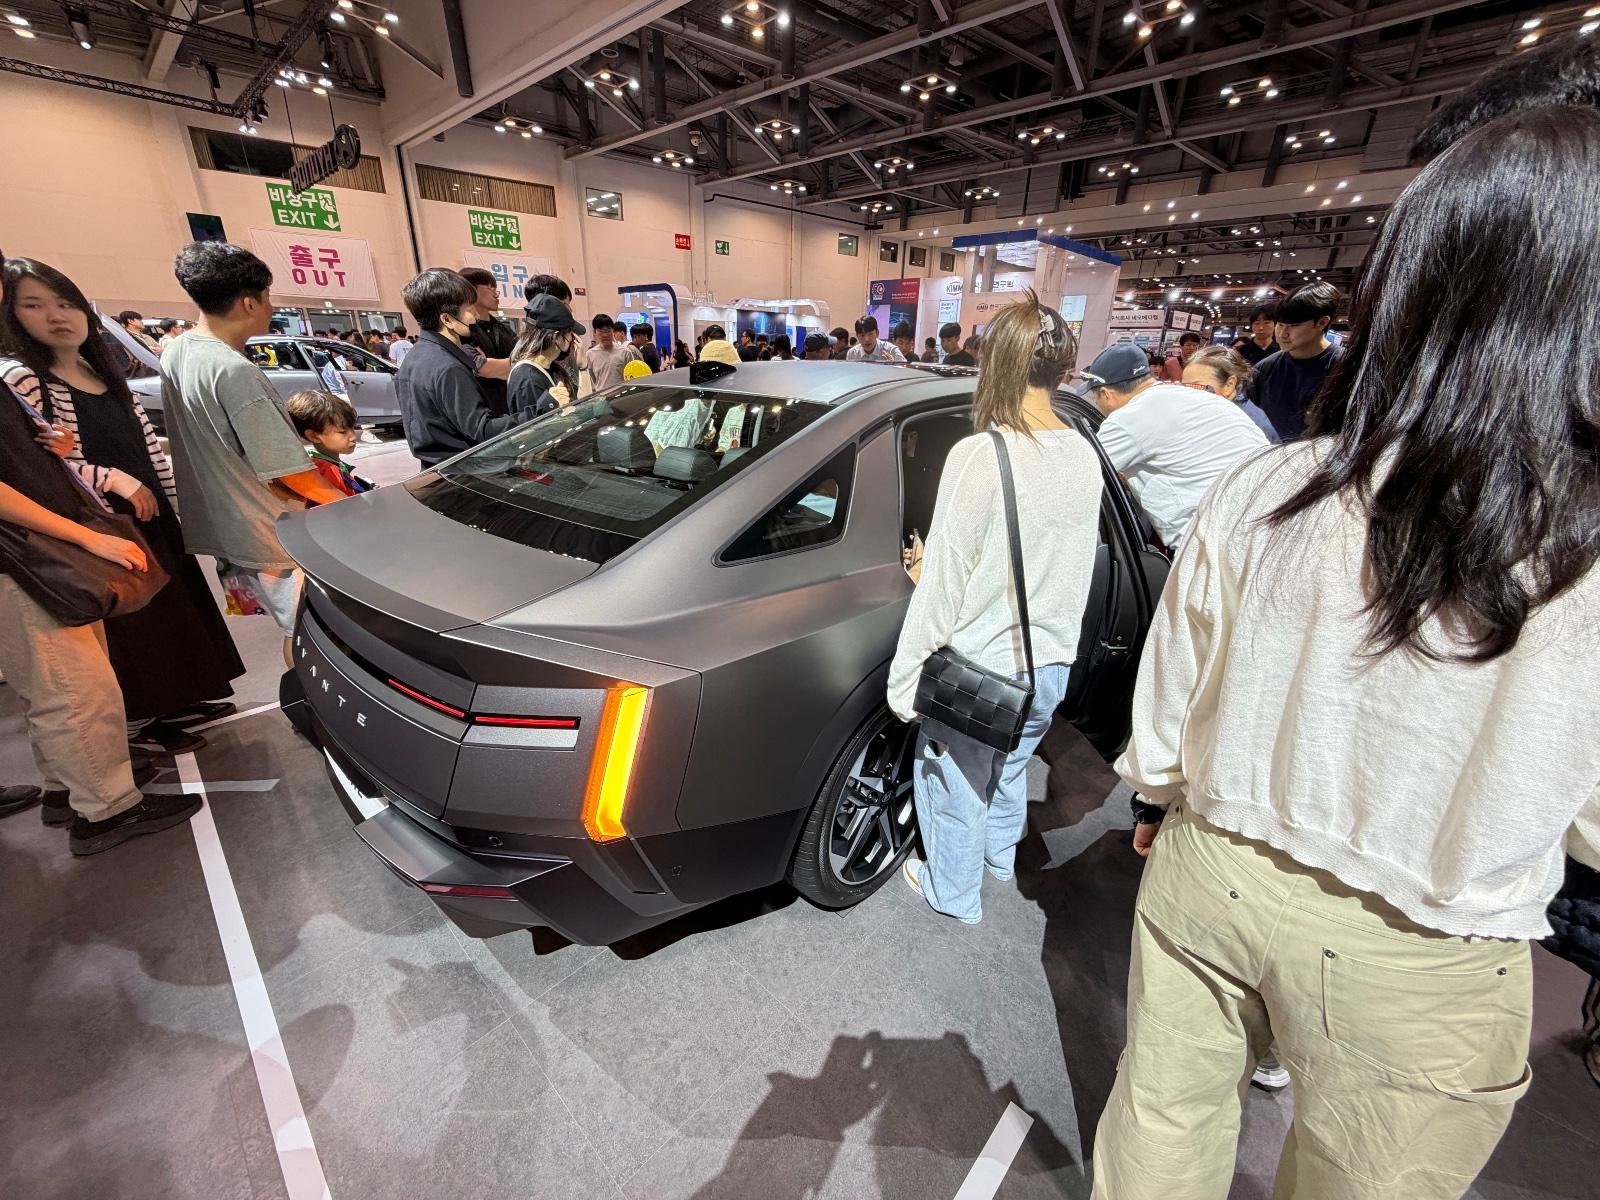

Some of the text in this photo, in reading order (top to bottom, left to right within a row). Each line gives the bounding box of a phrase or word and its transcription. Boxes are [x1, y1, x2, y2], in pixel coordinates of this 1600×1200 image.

[268, 187, 318, 209] 비상구
[277, 208, 317, 227] EXIT
[469, 213, 506, 232] 비상구
[475, 231, 505, 247] EXIT
[288, 244, 342, 269] 출구
[291, 268, 346, 288] OUT
[490, 263, 529, 284] 입구
[502, 283, 524, 299] IN
